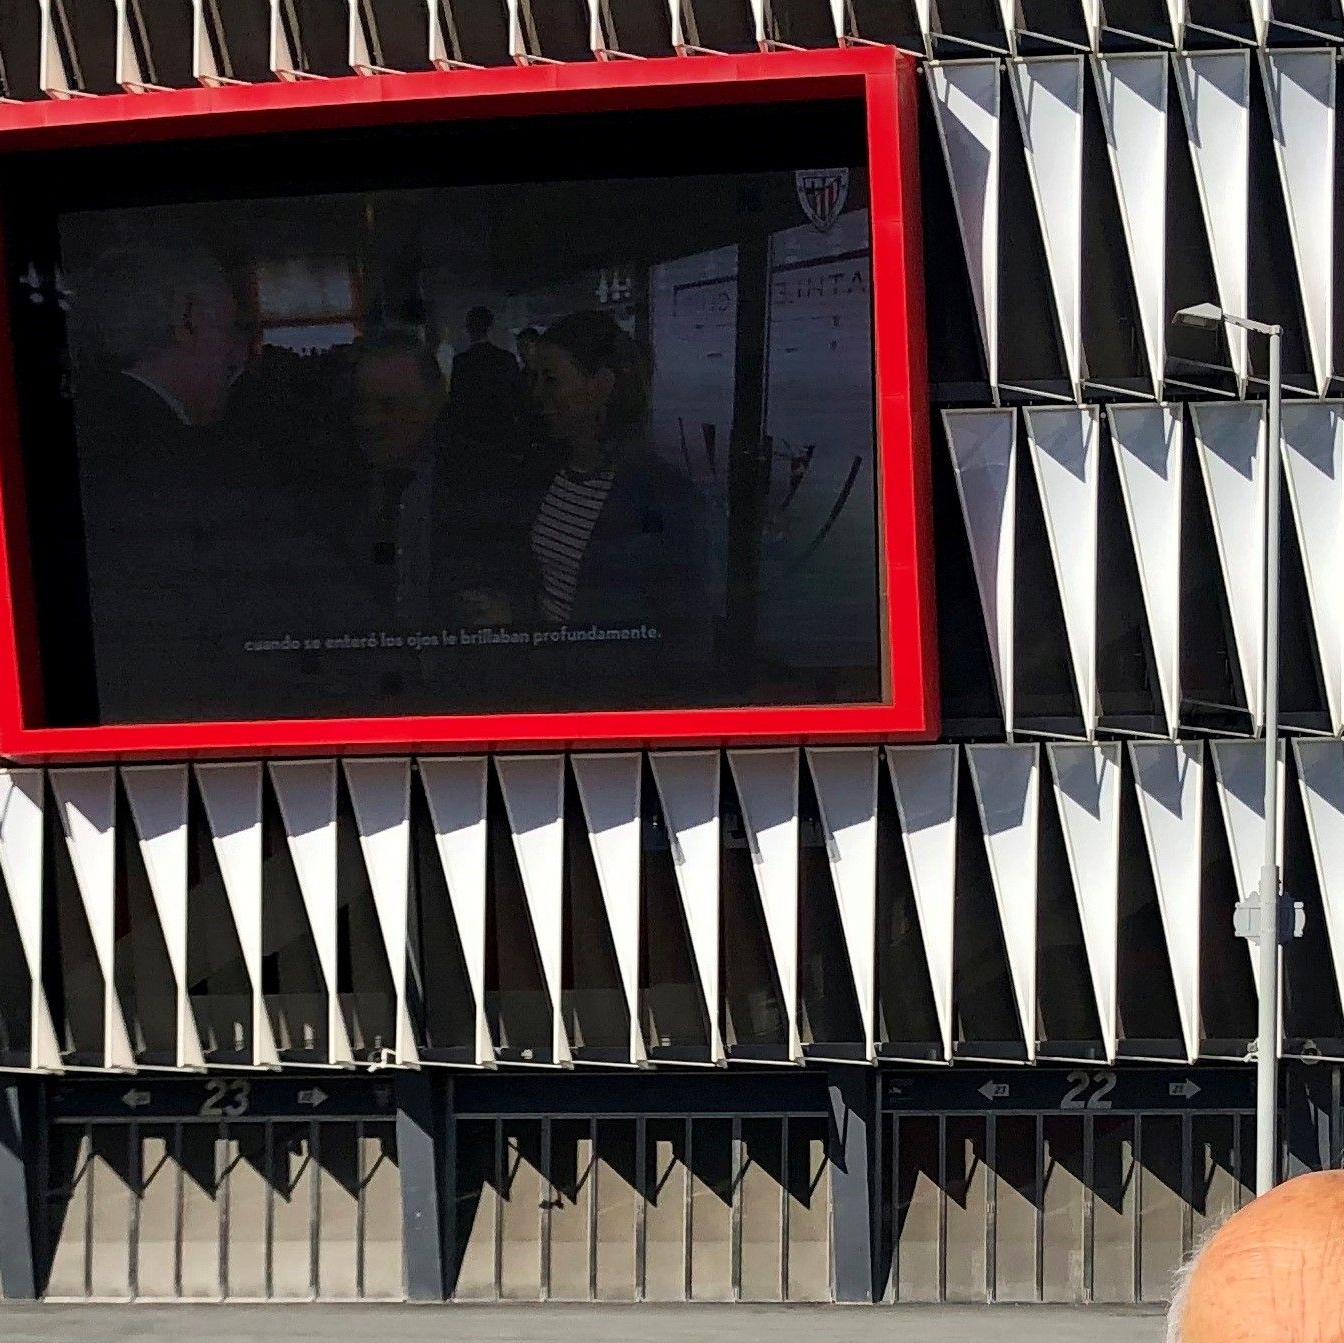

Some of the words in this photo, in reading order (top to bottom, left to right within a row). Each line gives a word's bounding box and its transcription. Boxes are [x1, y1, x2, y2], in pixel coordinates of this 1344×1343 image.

[243, 634, 301, 651] cuando
[303, 638, 321, 650] se
[323, 632, 378, 649] enteró
[380, 630, 404, 647] los
[406, 631, 439, 651] ojos
[441, 629, 457, 646] le
[460, 627, 529, 645] brillaban
[532, 624, 662, 647] profundamente.
[199, 1079, 250, 1117] 23
[1060, 1071, 1117, 1110] 22
